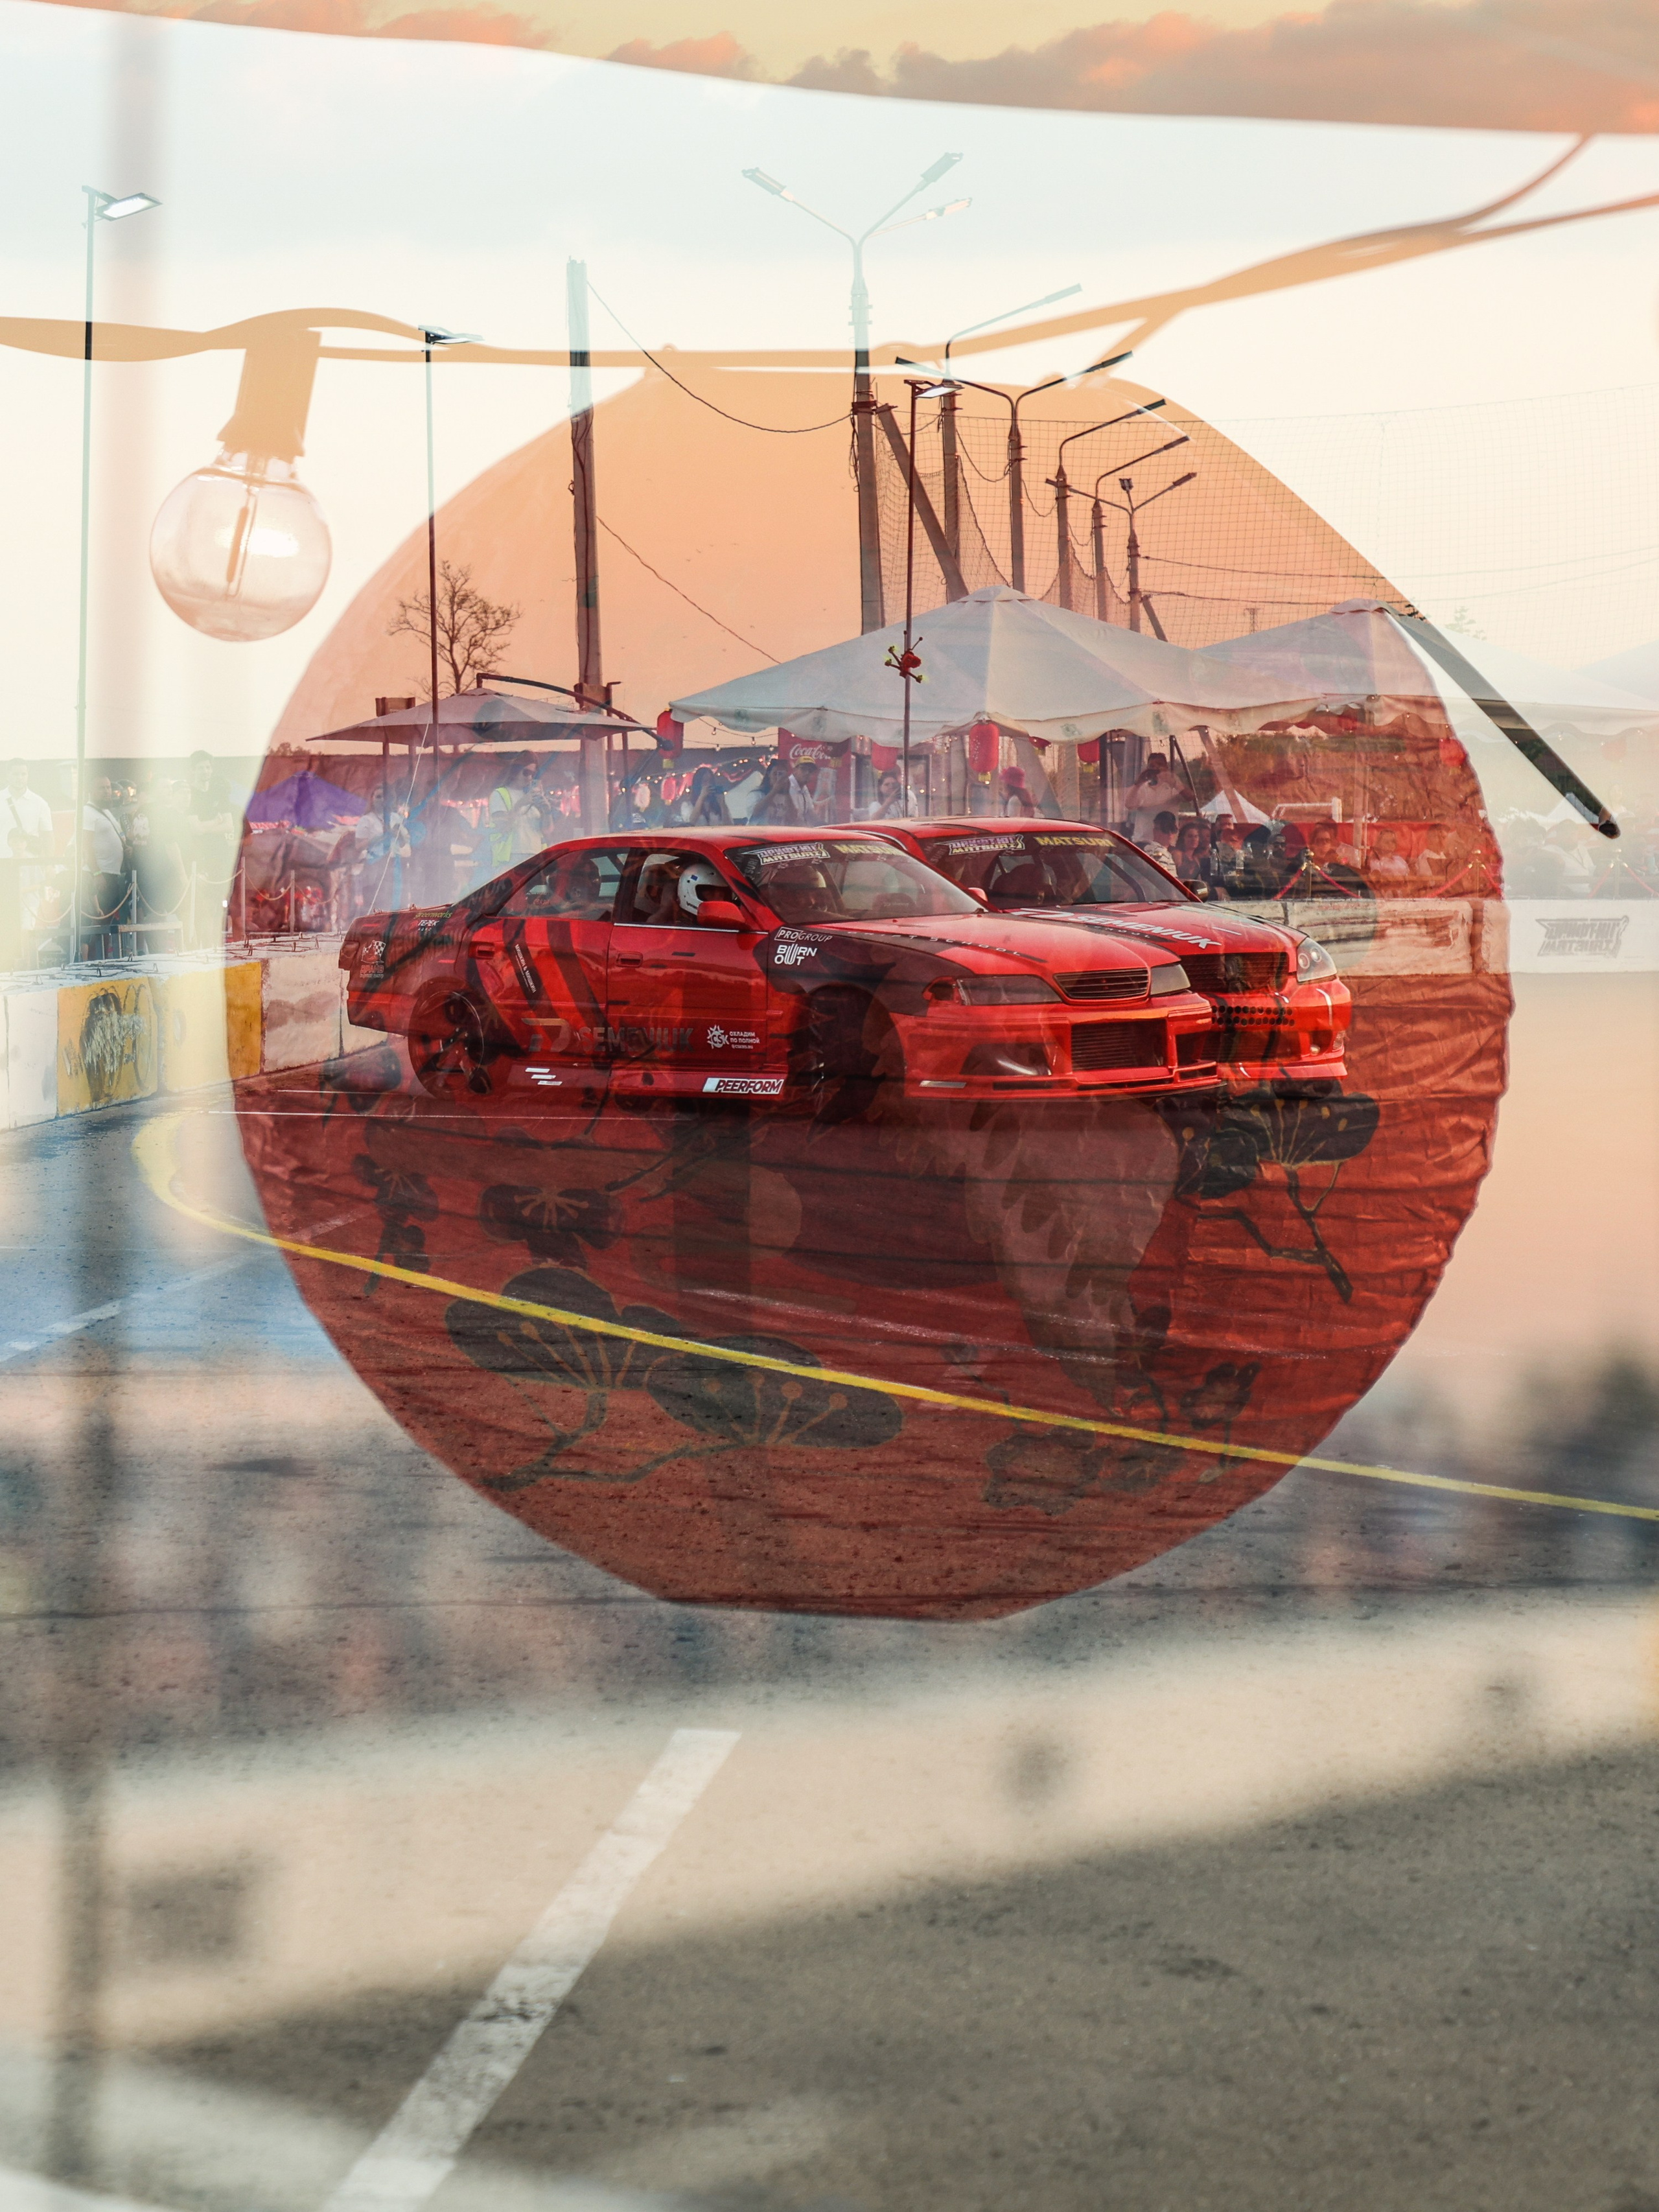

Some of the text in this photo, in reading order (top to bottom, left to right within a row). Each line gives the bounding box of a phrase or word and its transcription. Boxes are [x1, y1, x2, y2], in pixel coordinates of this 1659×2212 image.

[1034, 837, 1116, 847] MATSURI
[1069, 915, 1222, 949] SEMENIUK
[715, 1079, 783, 1093] PEERFORM
